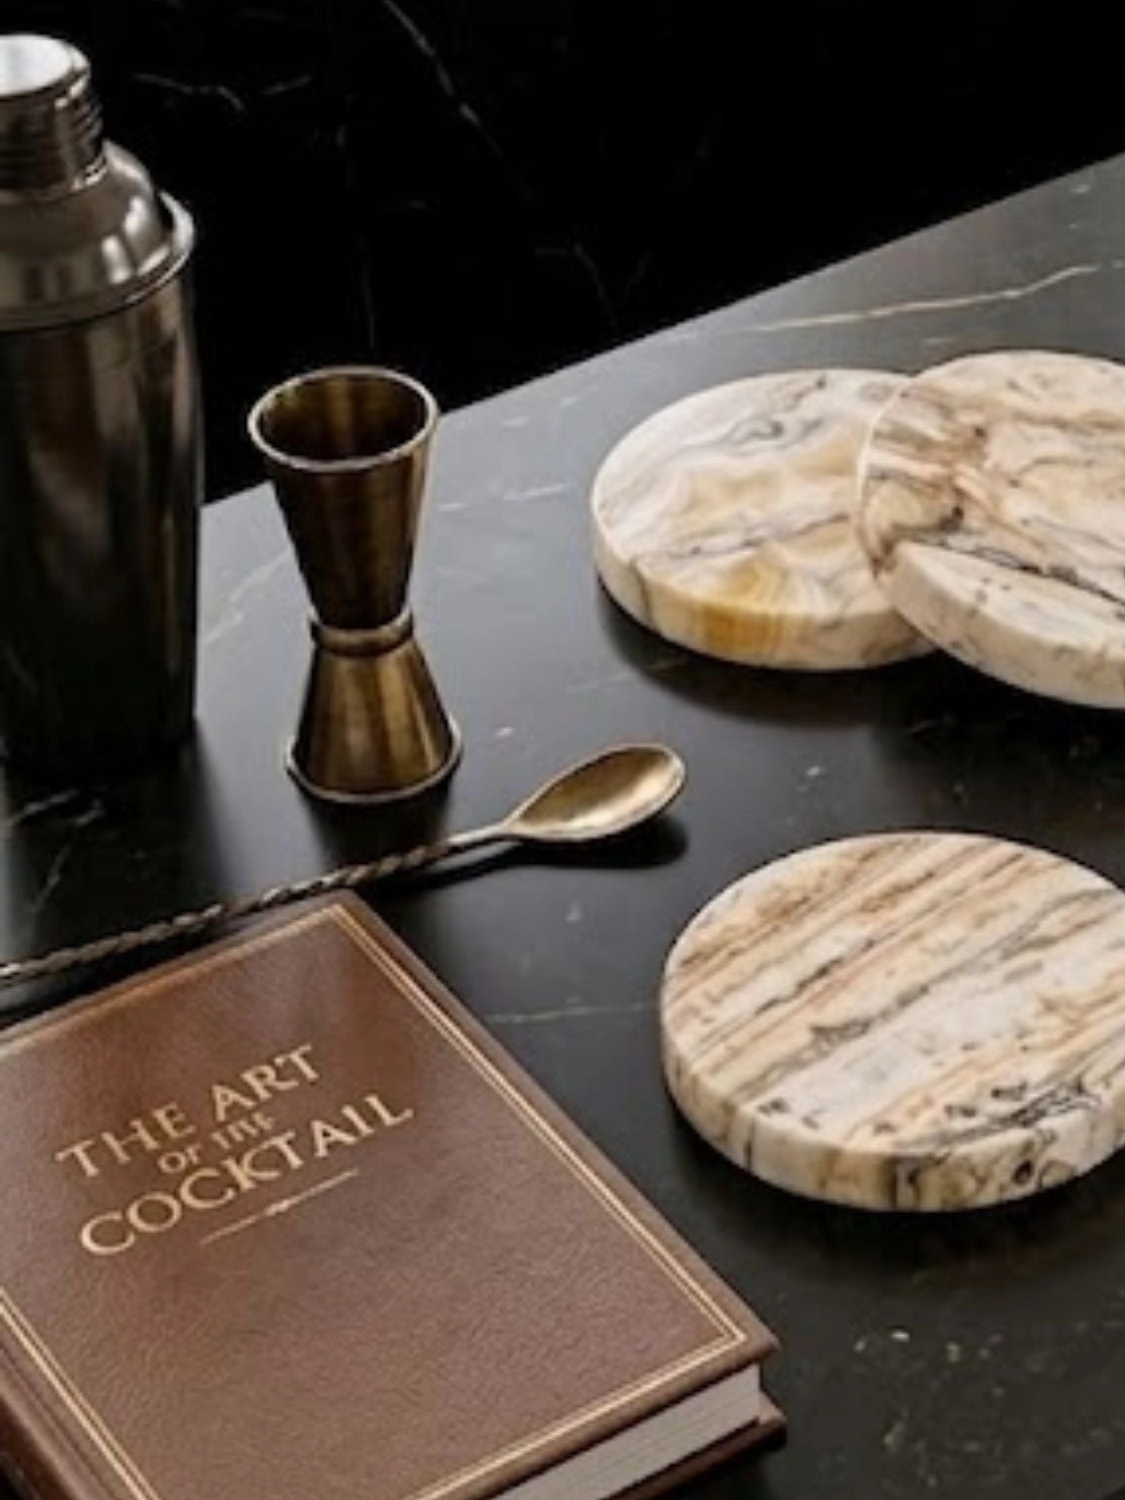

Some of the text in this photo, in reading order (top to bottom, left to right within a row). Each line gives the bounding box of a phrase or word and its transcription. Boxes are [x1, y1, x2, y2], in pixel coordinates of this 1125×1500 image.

[55, 1044, 319, 1178] THE ART
[80, 1094, 415, 1255] COCKTAIL
